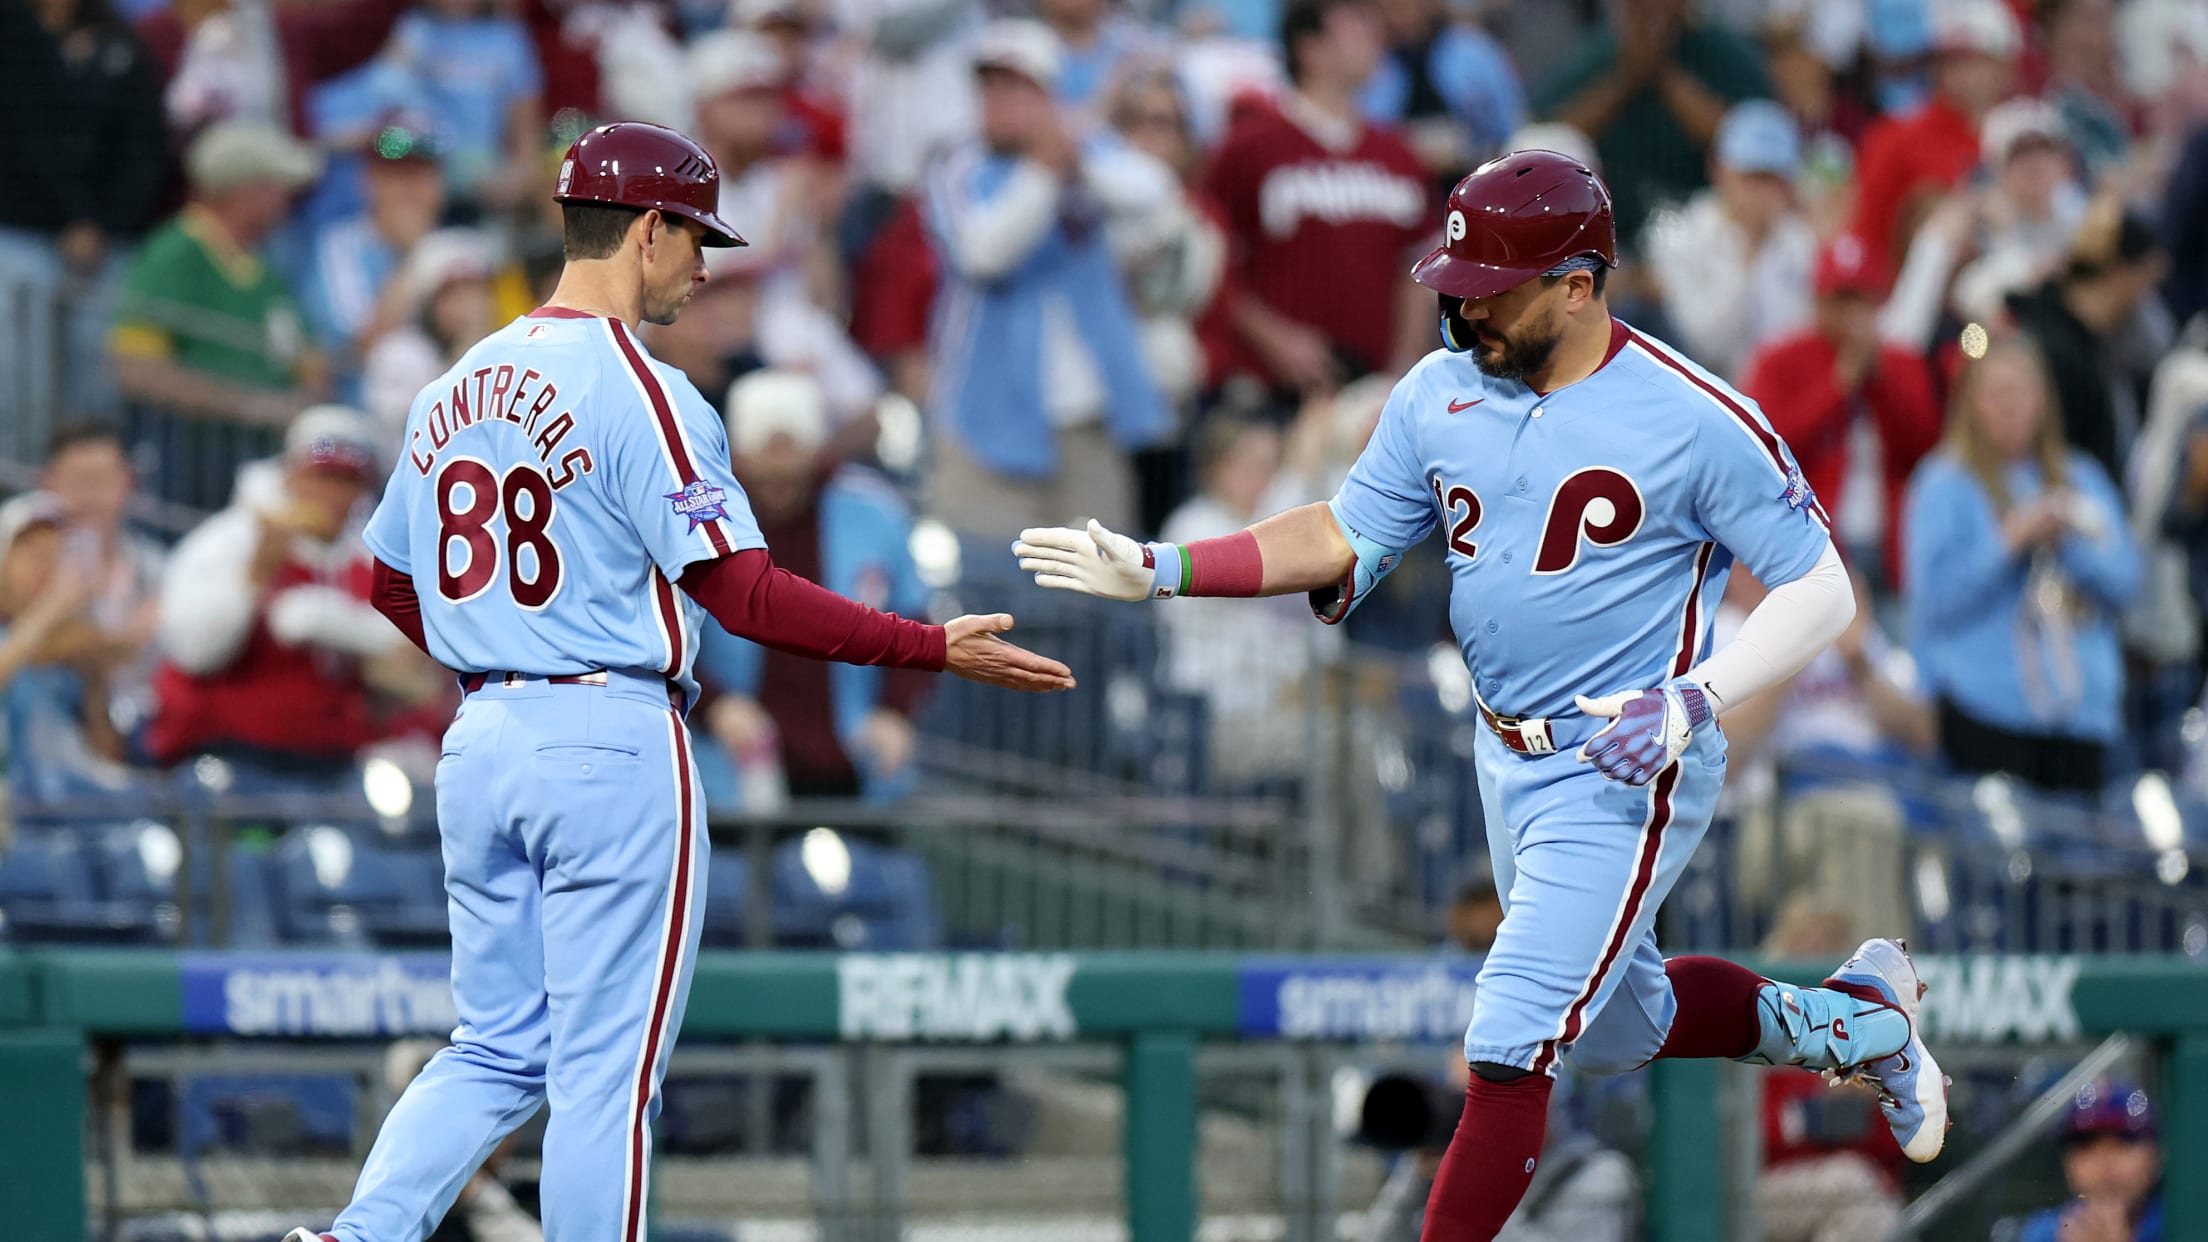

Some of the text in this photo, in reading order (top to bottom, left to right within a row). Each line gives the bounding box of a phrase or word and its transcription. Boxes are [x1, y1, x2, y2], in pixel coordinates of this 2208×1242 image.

[1446, 210, 1467, 249] P
[409, 362, 595, 493] CONTRERAS
[434, 454, 565, 613] 88
[1530, 464, 1646, 576] P
[1526, 734, 1547, 752] 12
[1918, 955, 2080, 1040] MAX
